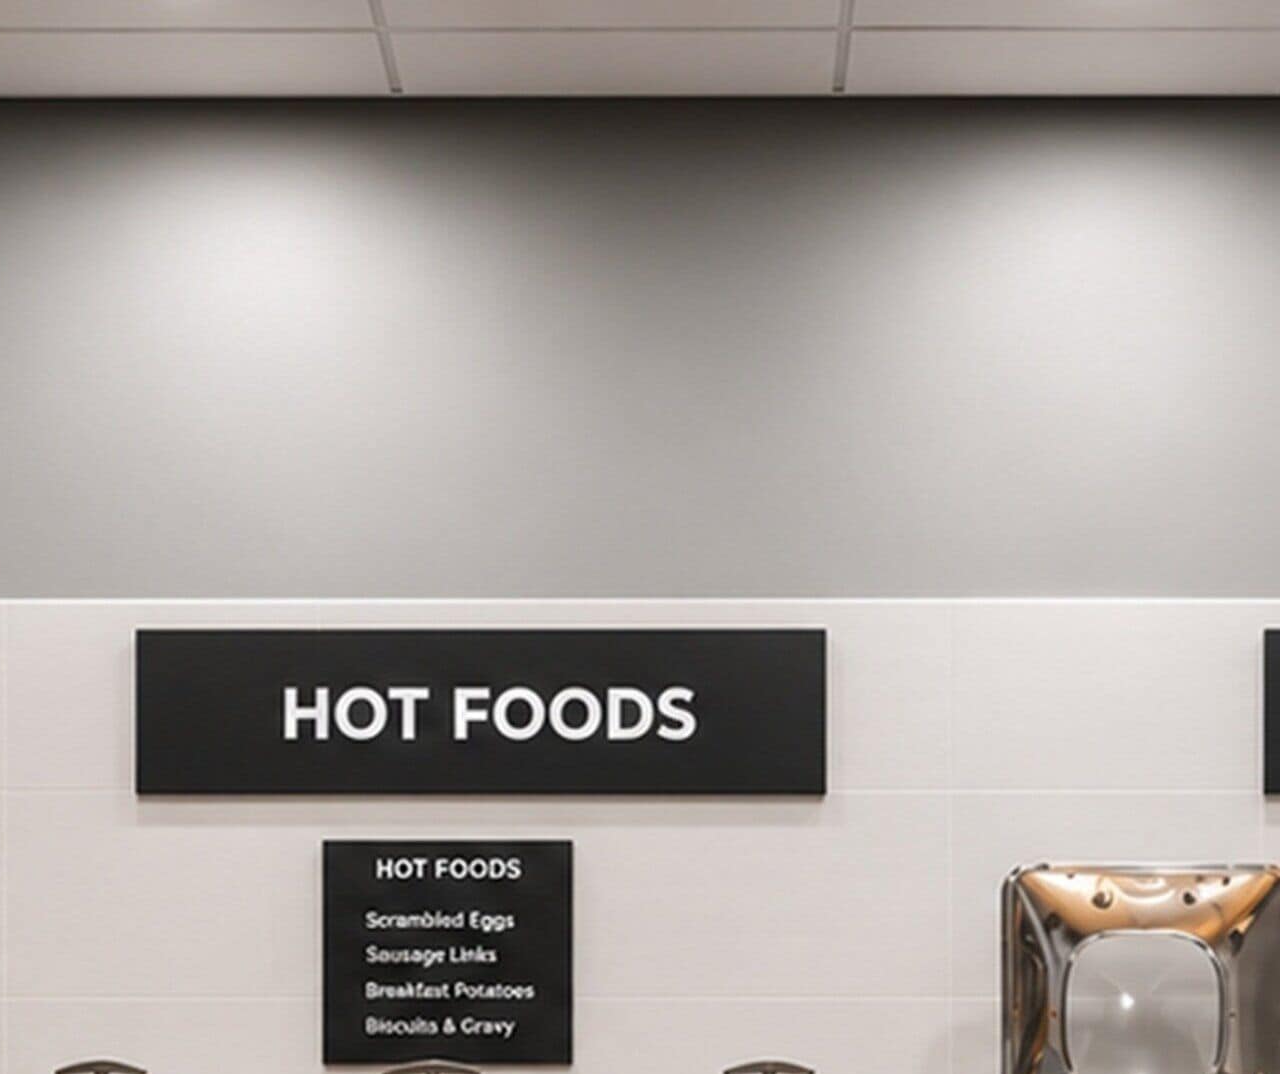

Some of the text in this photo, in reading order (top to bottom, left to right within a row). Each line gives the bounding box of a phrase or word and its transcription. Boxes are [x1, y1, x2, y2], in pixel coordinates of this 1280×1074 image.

[283, 686, 697, 742] HOT FOODS
[375, 858, 523, 880] HOT FOODS
[365, 911, 516, 933] Scrambled Eggs
[460, 1016, 516, 1039] Gravy
